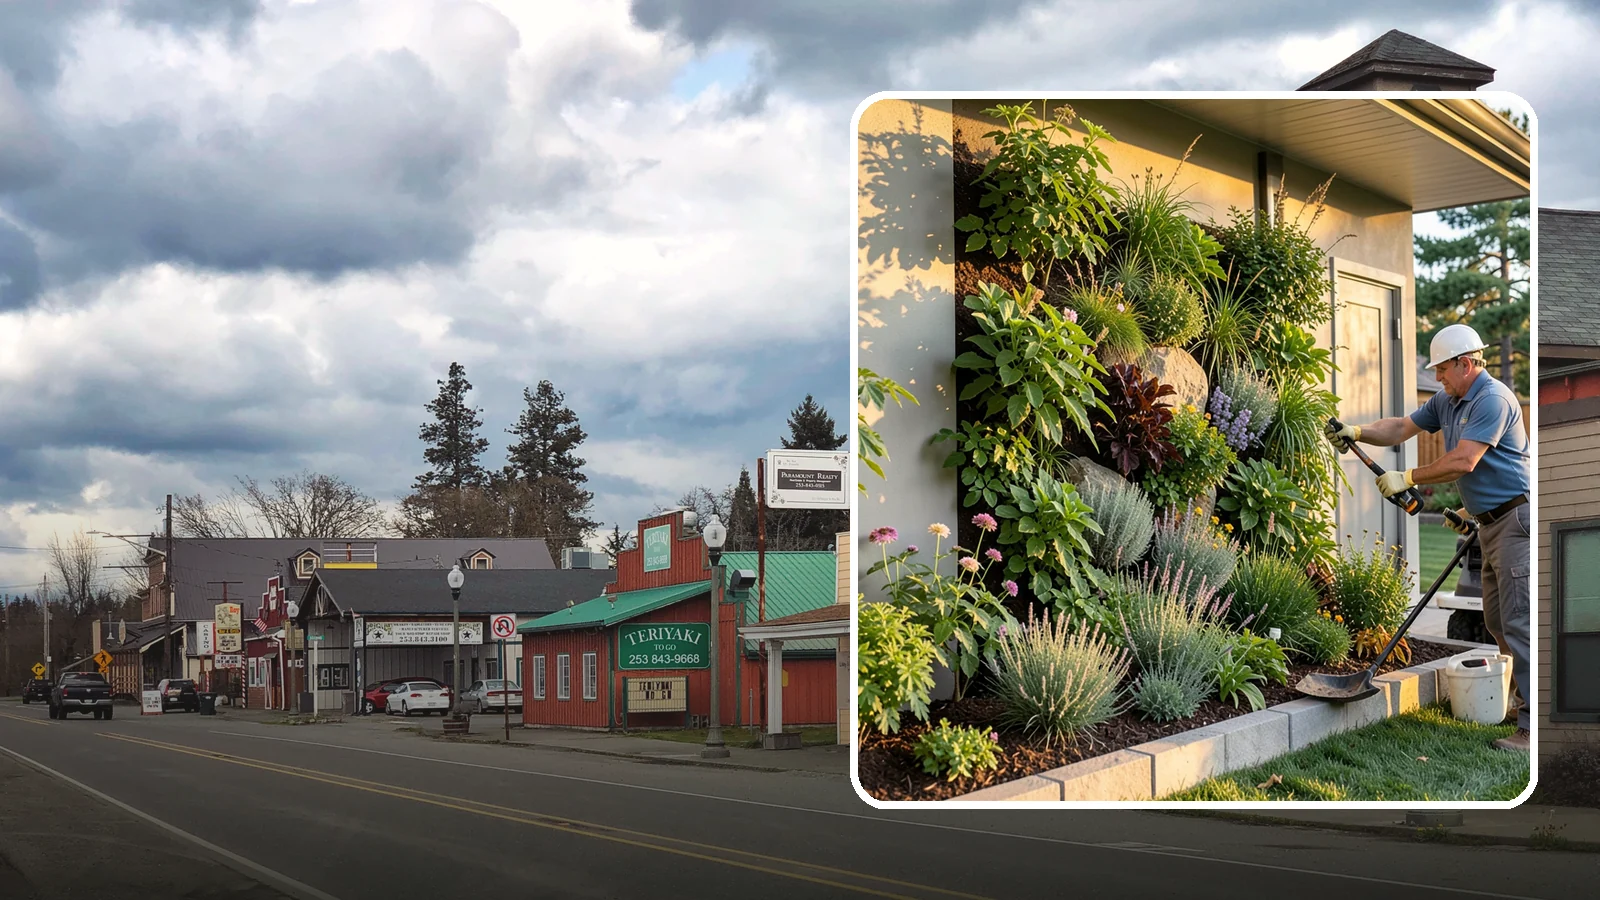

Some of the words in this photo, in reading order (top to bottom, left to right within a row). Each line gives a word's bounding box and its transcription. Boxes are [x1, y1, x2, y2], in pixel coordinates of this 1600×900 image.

[625, 627, 702, 646] TERIYAKI
[629, 655, 648, 664] 253
[651, 654, 700, 664] 843-9668
